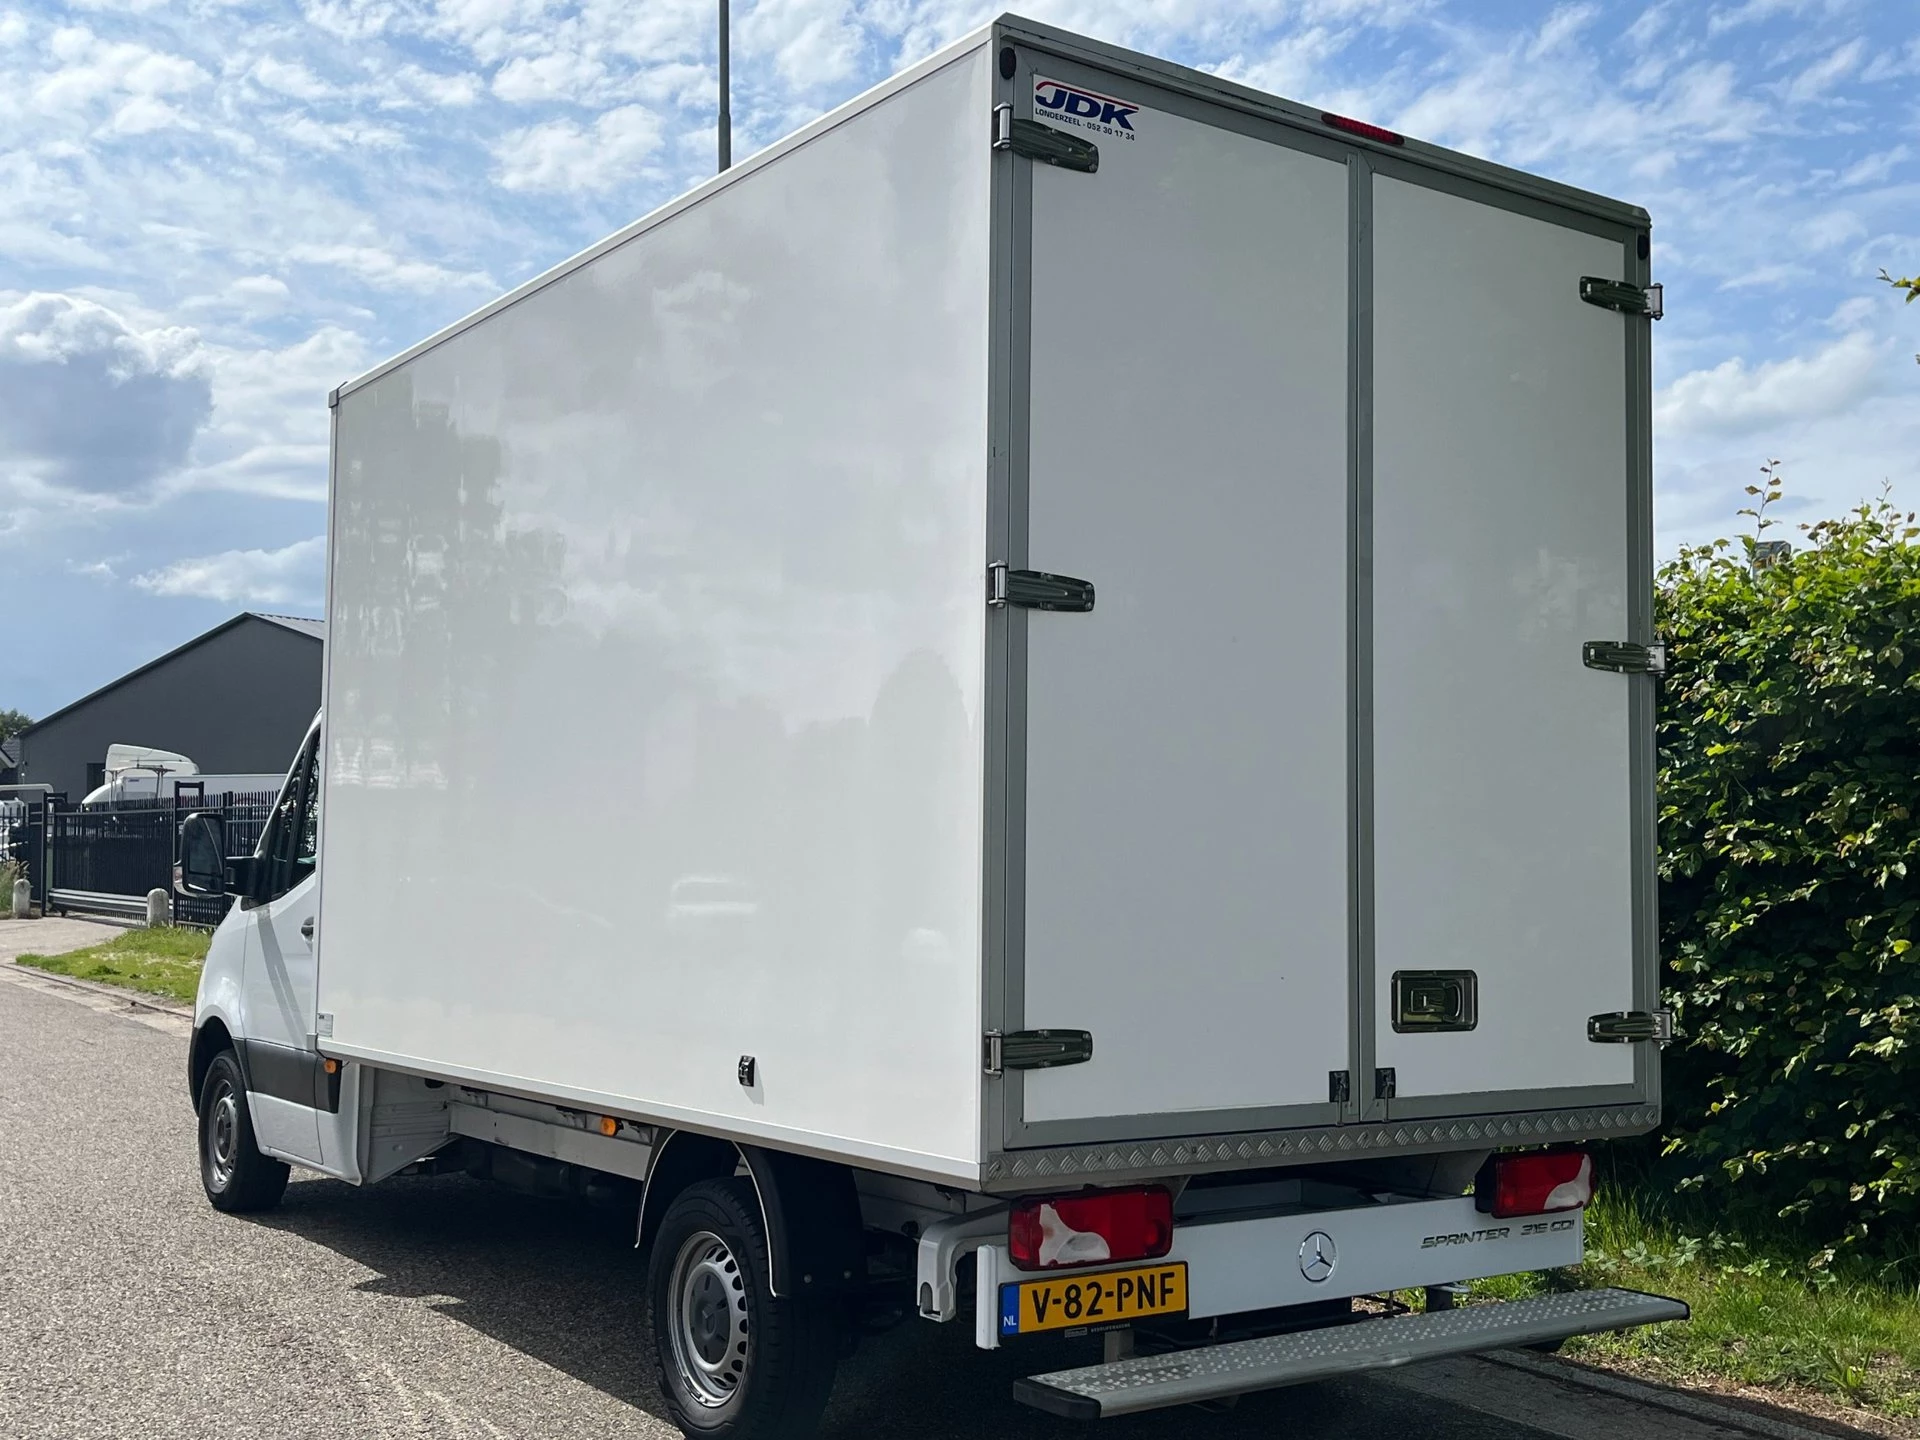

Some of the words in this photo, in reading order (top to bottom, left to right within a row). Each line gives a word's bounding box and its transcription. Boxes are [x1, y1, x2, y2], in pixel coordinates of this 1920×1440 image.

[1035, 88, 1138, 131] JDK
[1035, 107, 1081, 127] LONDERZEEL
[1086, 122, 1101, 132] 052
[1103, 126, 1113, 135] 30
[1114, 130, 1123, 138] 17
[1125, 133, 1135, 141] 34
[1420, 1227, 1510, 1249] SPRINTER
[1550, 1219, 1574, 1231] CDI
[1003, 1314, 1016, 1327] NL
[1032, 1272, 1175, 1324] V-82-PNF
